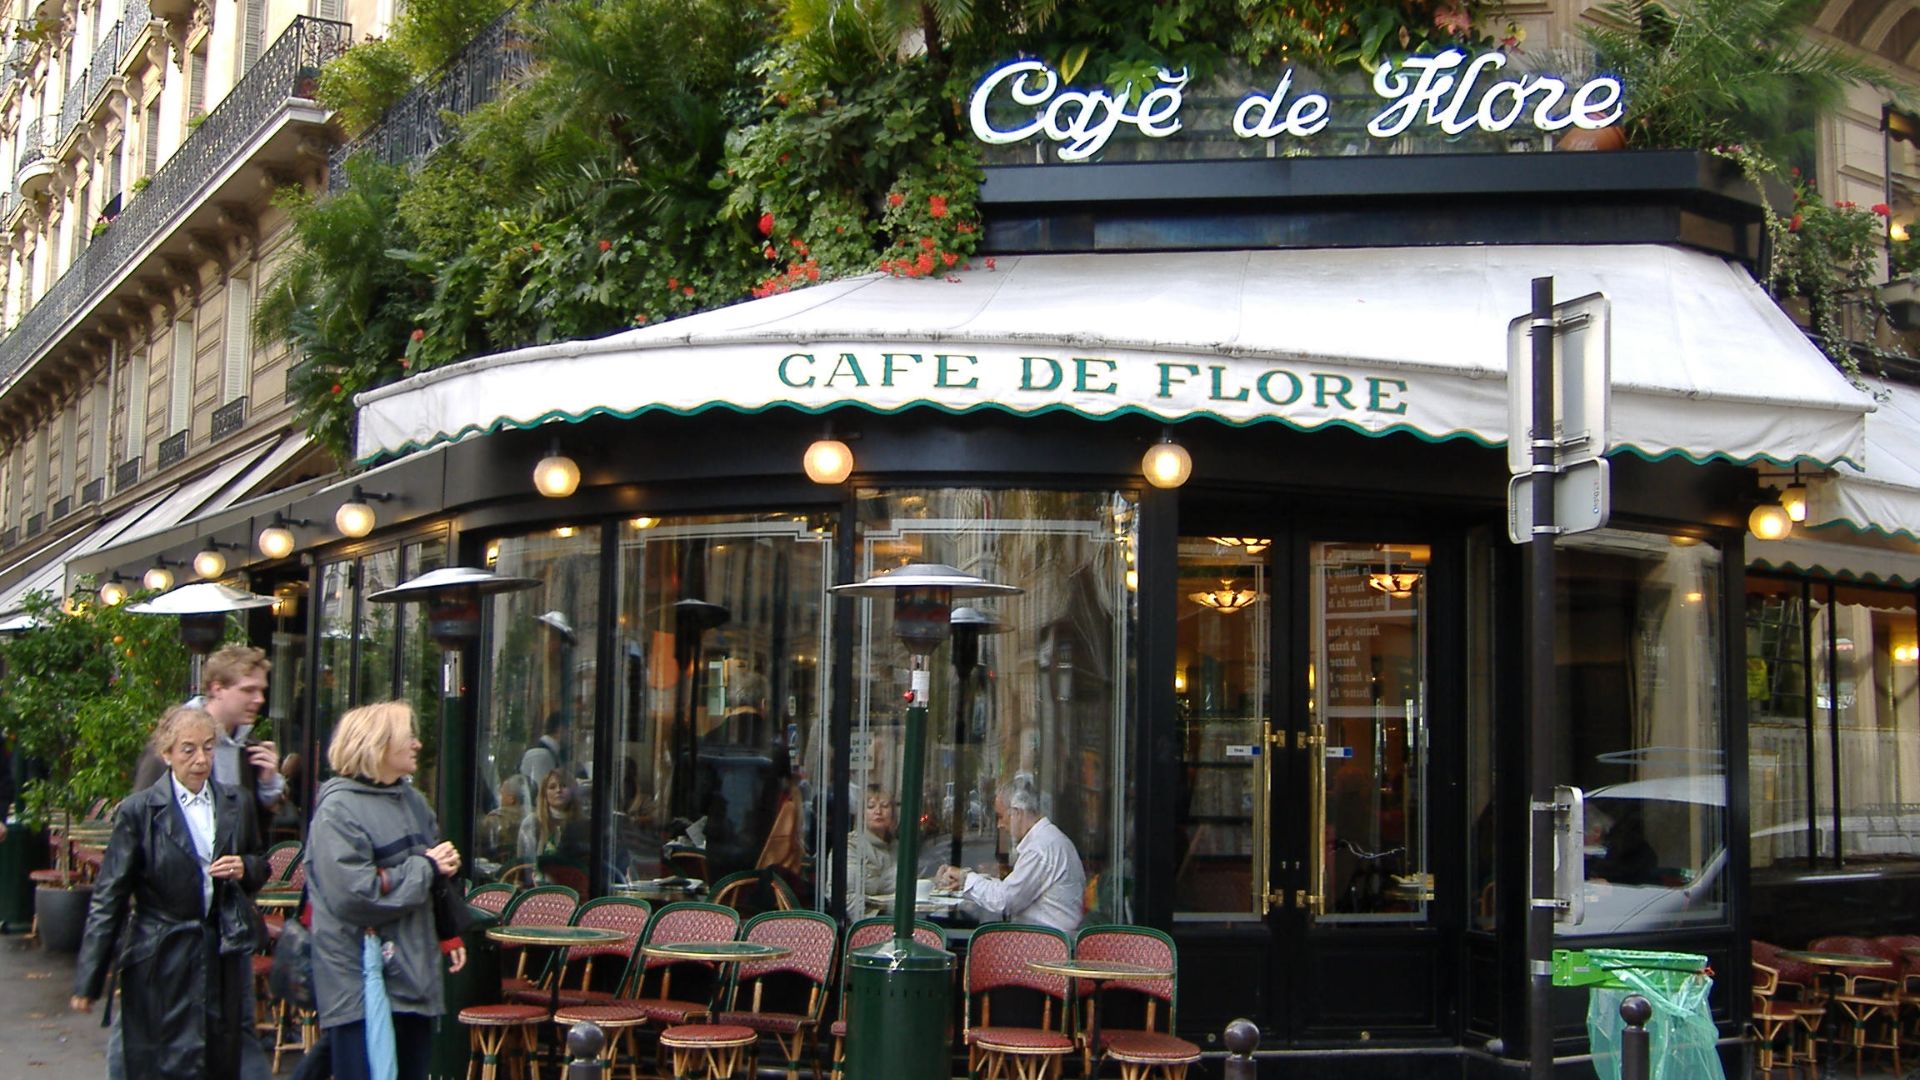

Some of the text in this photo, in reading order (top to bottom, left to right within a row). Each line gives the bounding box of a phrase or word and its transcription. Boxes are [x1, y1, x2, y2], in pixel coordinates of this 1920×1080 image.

[1232, 68, 1330, 139] de
[1366, 49, 1624, 140] Flore
[777, 351, 1409, 416] CAFE DE FLORE
